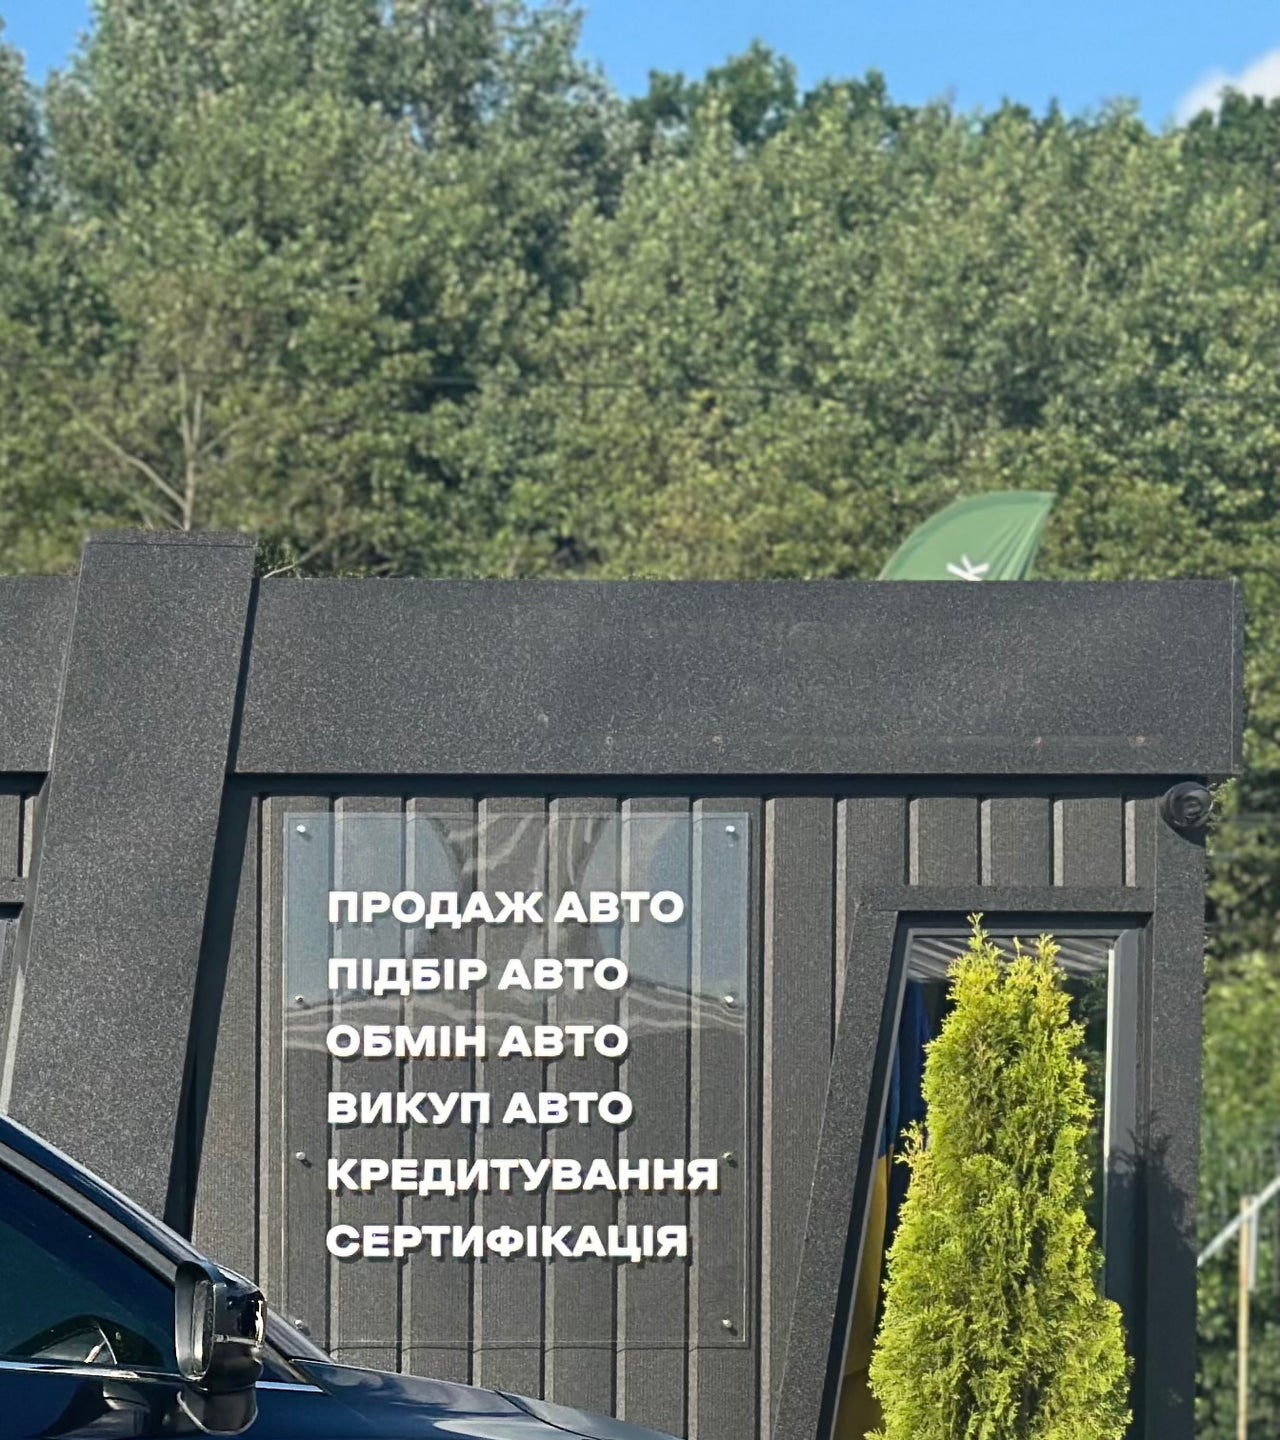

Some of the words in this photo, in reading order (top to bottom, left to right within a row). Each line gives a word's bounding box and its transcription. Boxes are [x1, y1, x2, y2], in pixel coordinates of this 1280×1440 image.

[328, 890, 544, 929] ПРОДАЖ
[553, 890, 684, 923] АВТО
[328, 958, 488, 996] ПІДБІР
[497, 957, 628, 990] АВТО
[326, 1024, 486, 1057] ОБМІН
[497, 1024, 628, 1057] АВТО
[327, 1091, 490, 1125] ВИКУП
[502, 1091, 633, 1124] АВТО
[327, 1158, 718, 1196] КРЕДИТУВАННЯ
[326, 1224, 687, 1263] СЕРТИФІКАЦІЯ
